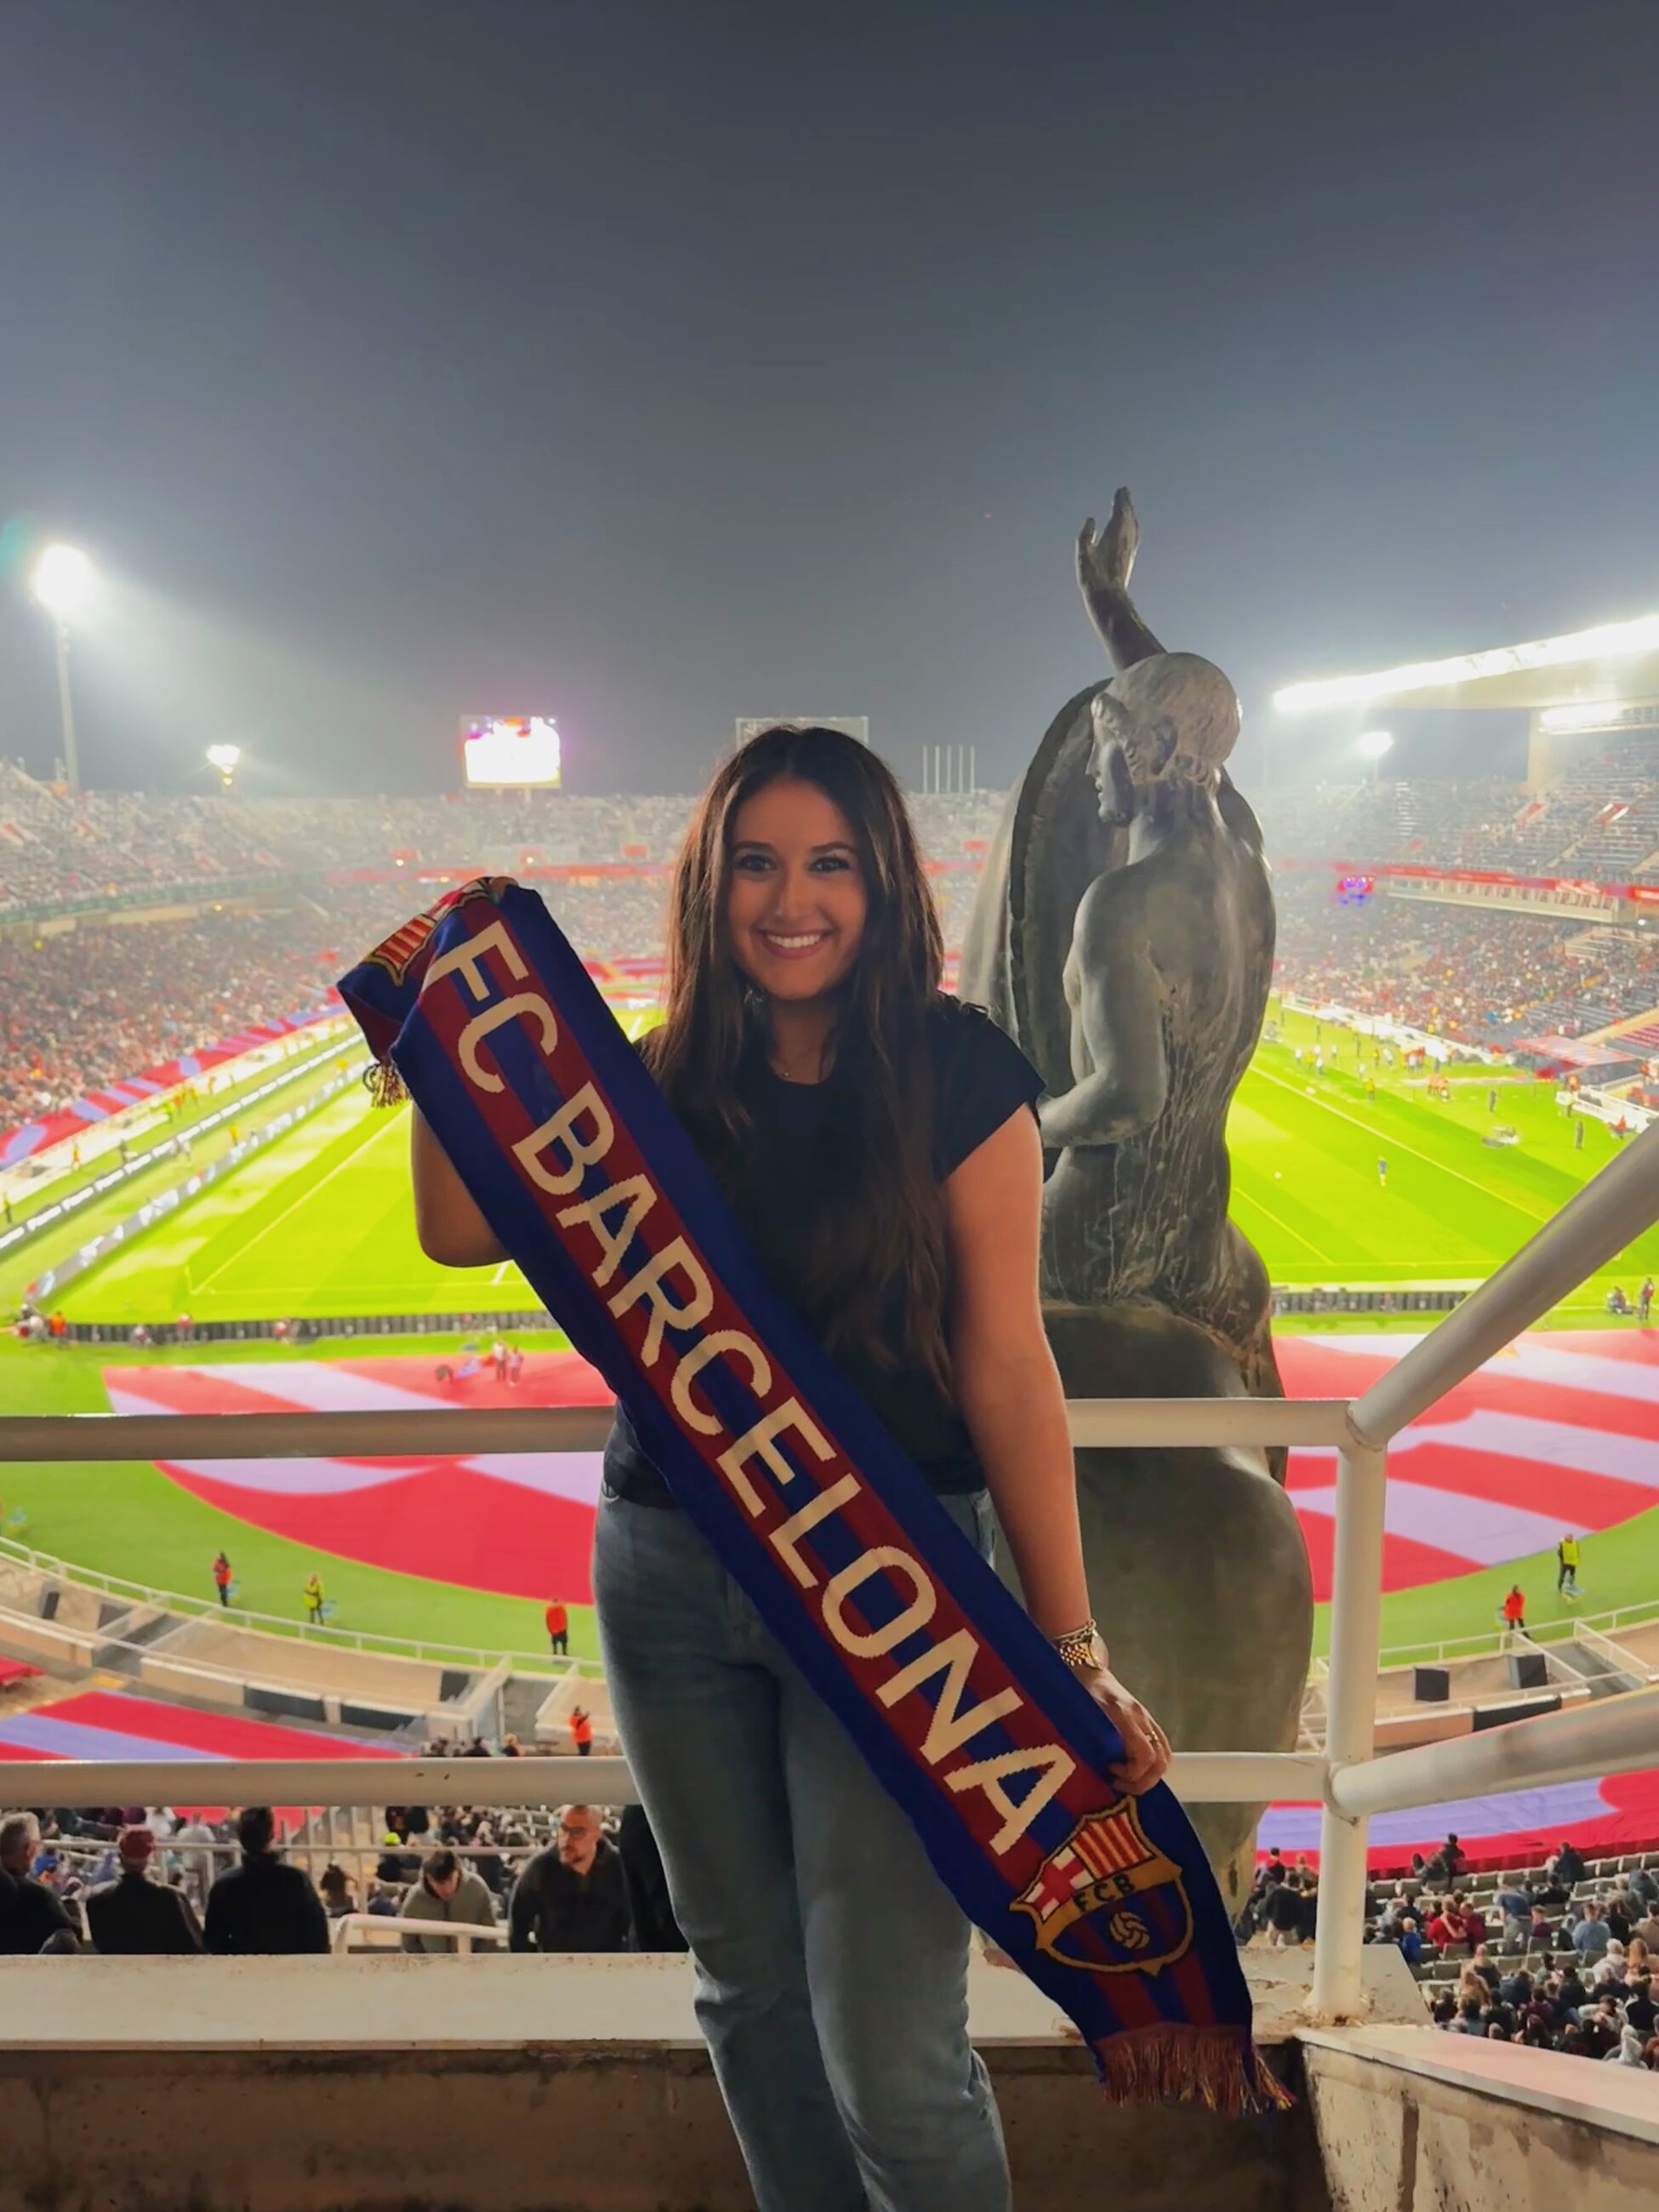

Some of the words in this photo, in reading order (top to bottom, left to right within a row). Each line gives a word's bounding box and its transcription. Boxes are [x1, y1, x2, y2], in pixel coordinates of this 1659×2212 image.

[421, 920, 558, 1094] FC
[510, 1080, 1076, 1856] BARCELONA
[1073, 1873, 1136, 1913] FCB
